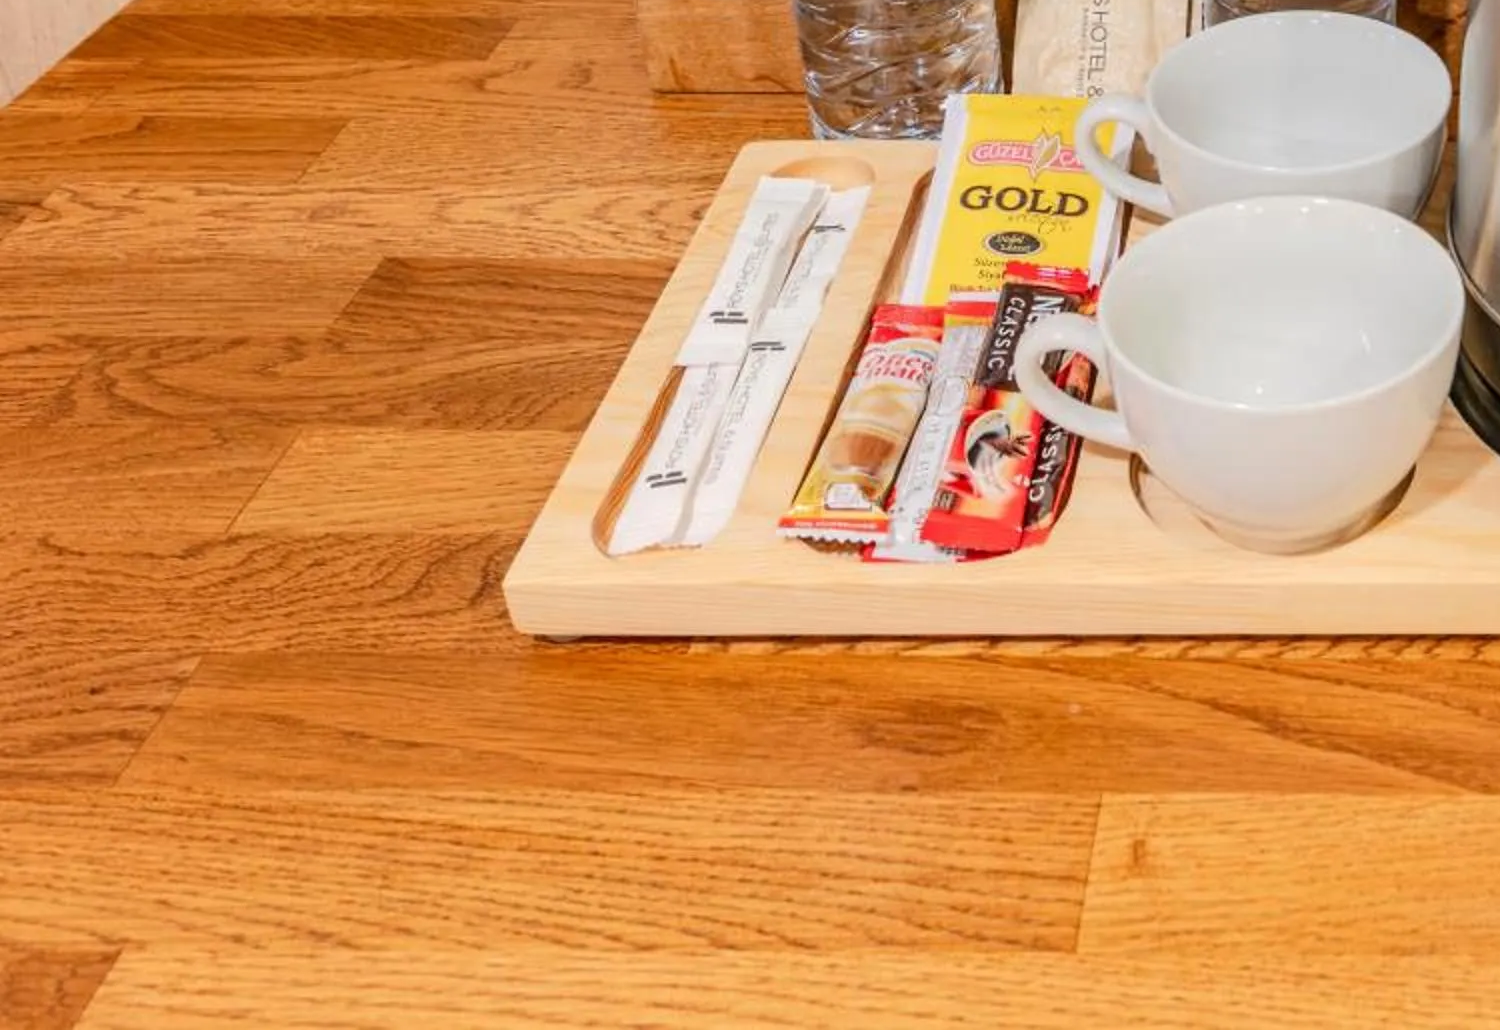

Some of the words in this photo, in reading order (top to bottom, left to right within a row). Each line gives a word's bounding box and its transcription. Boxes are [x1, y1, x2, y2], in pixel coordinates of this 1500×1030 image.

[1087, 11, 1110, 80] HOTEL
[959, 185, 1090, 217] GOLD
[987, 295, 1027, 370] CLASSIC
